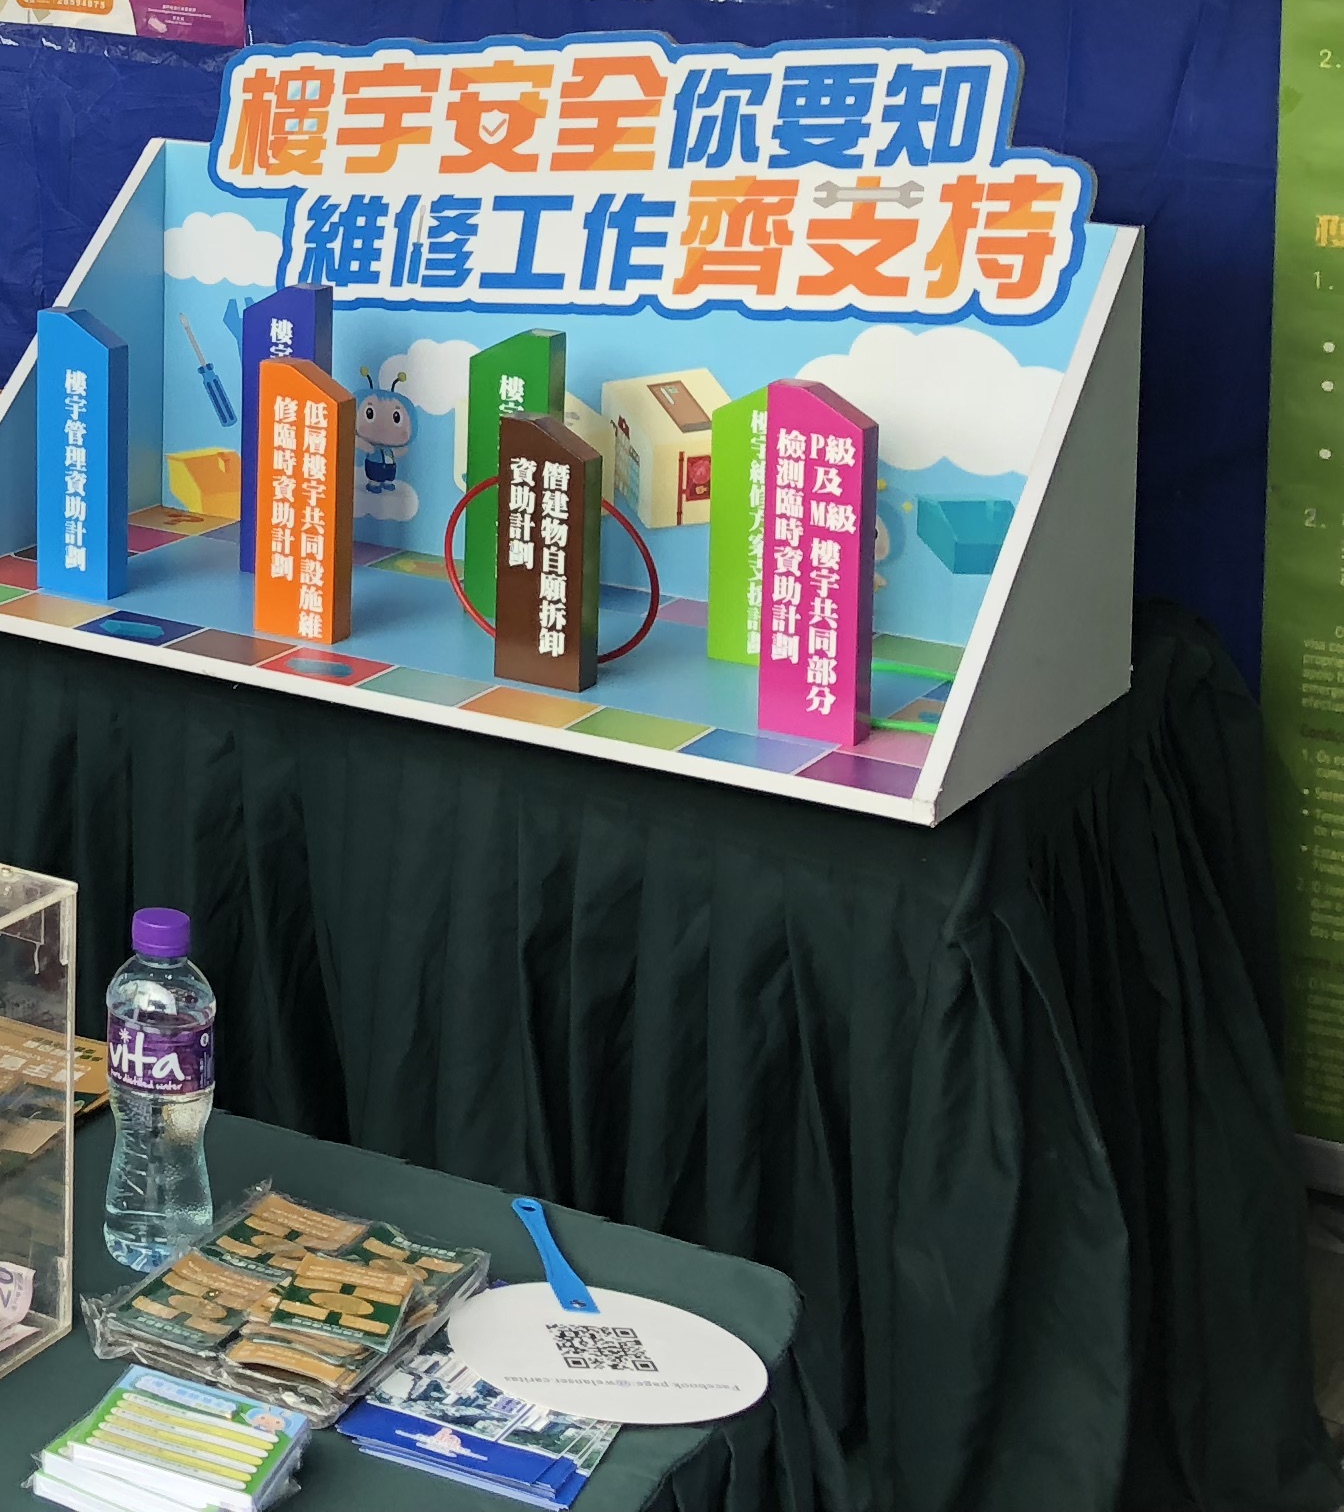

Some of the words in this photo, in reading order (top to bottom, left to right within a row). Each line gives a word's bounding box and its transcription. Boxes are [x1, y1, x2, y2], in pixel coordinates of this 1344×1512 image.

[229, 54, 992, 176] 樓宇安全你要知
[1319, 48, 1341, 69] 2.
[299, 174, 1065, 300] 維修工作齊支持
[63, 368, 88, 572] 樓宇管理資助計劃
[270, 394, 299, 582] 修臨時資助計劃
[297, 399, 328, 640] 低層樓宇共同設施維
[508, 456, 537, 570] 資助計劃
[538, 460, 571, 659] 僭建物自願拆卸
[771, 427, 807, 665] 檢測臨時資助計劃
[109, 1028, 186, 1081] vita
[673, 1381, 741, 1392] Facebook
